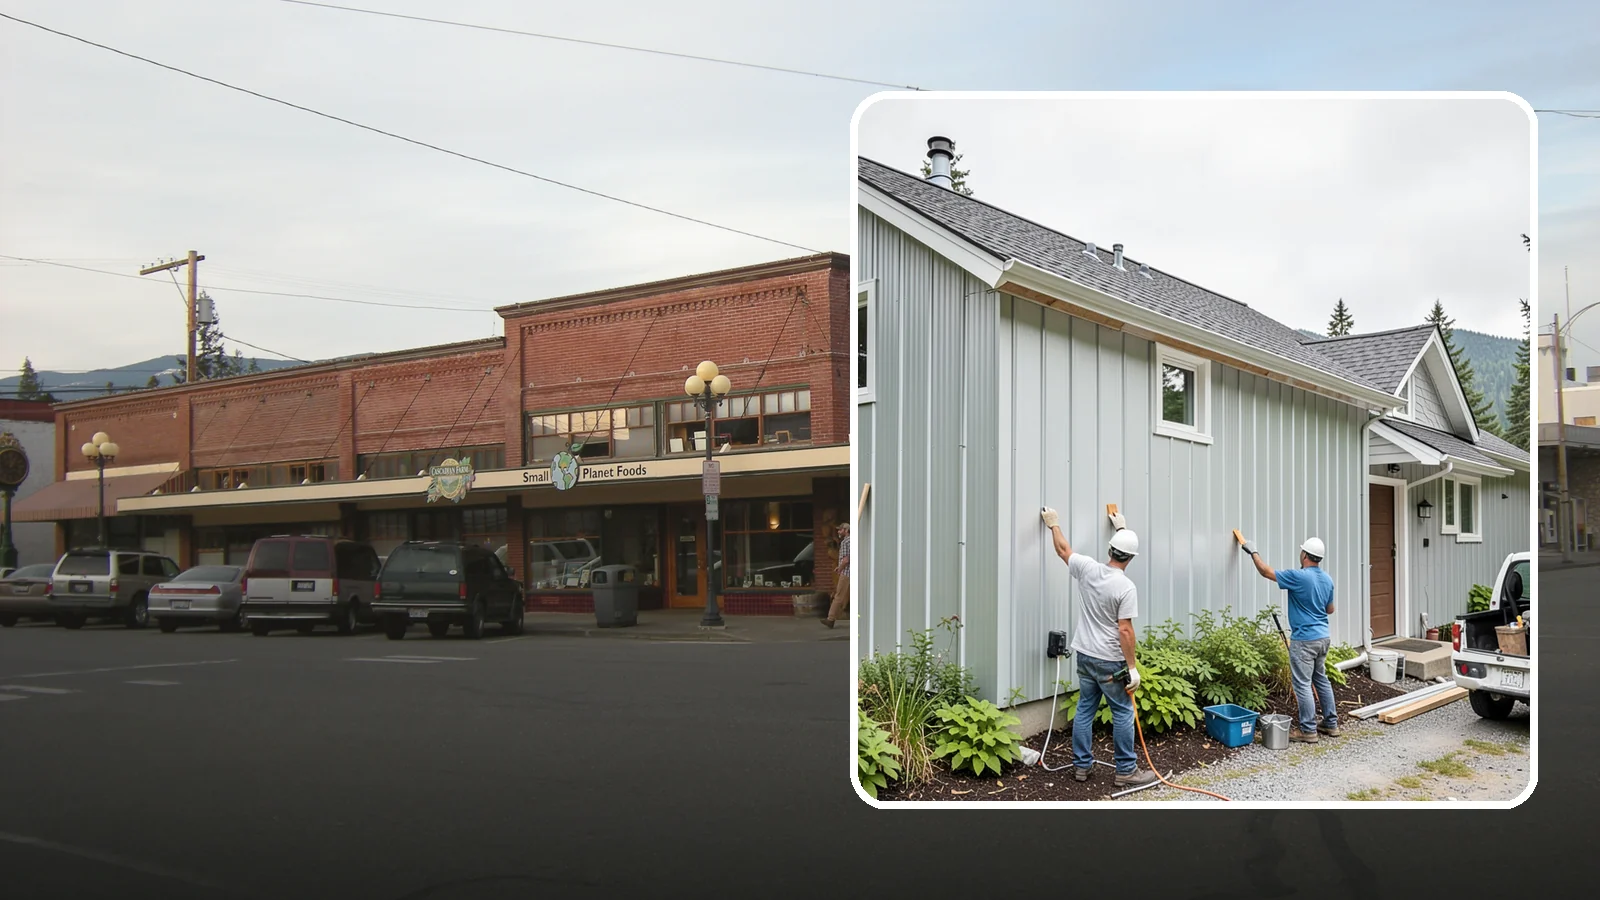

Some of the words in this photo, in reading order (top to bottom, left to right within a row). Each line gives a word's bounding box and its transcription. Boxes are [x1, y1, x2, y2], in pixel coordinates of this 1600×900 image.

[523, 471, 548, 482] Small
[583, 468, 613, 479] Planet
[617, 465, 646, 476] Foods
